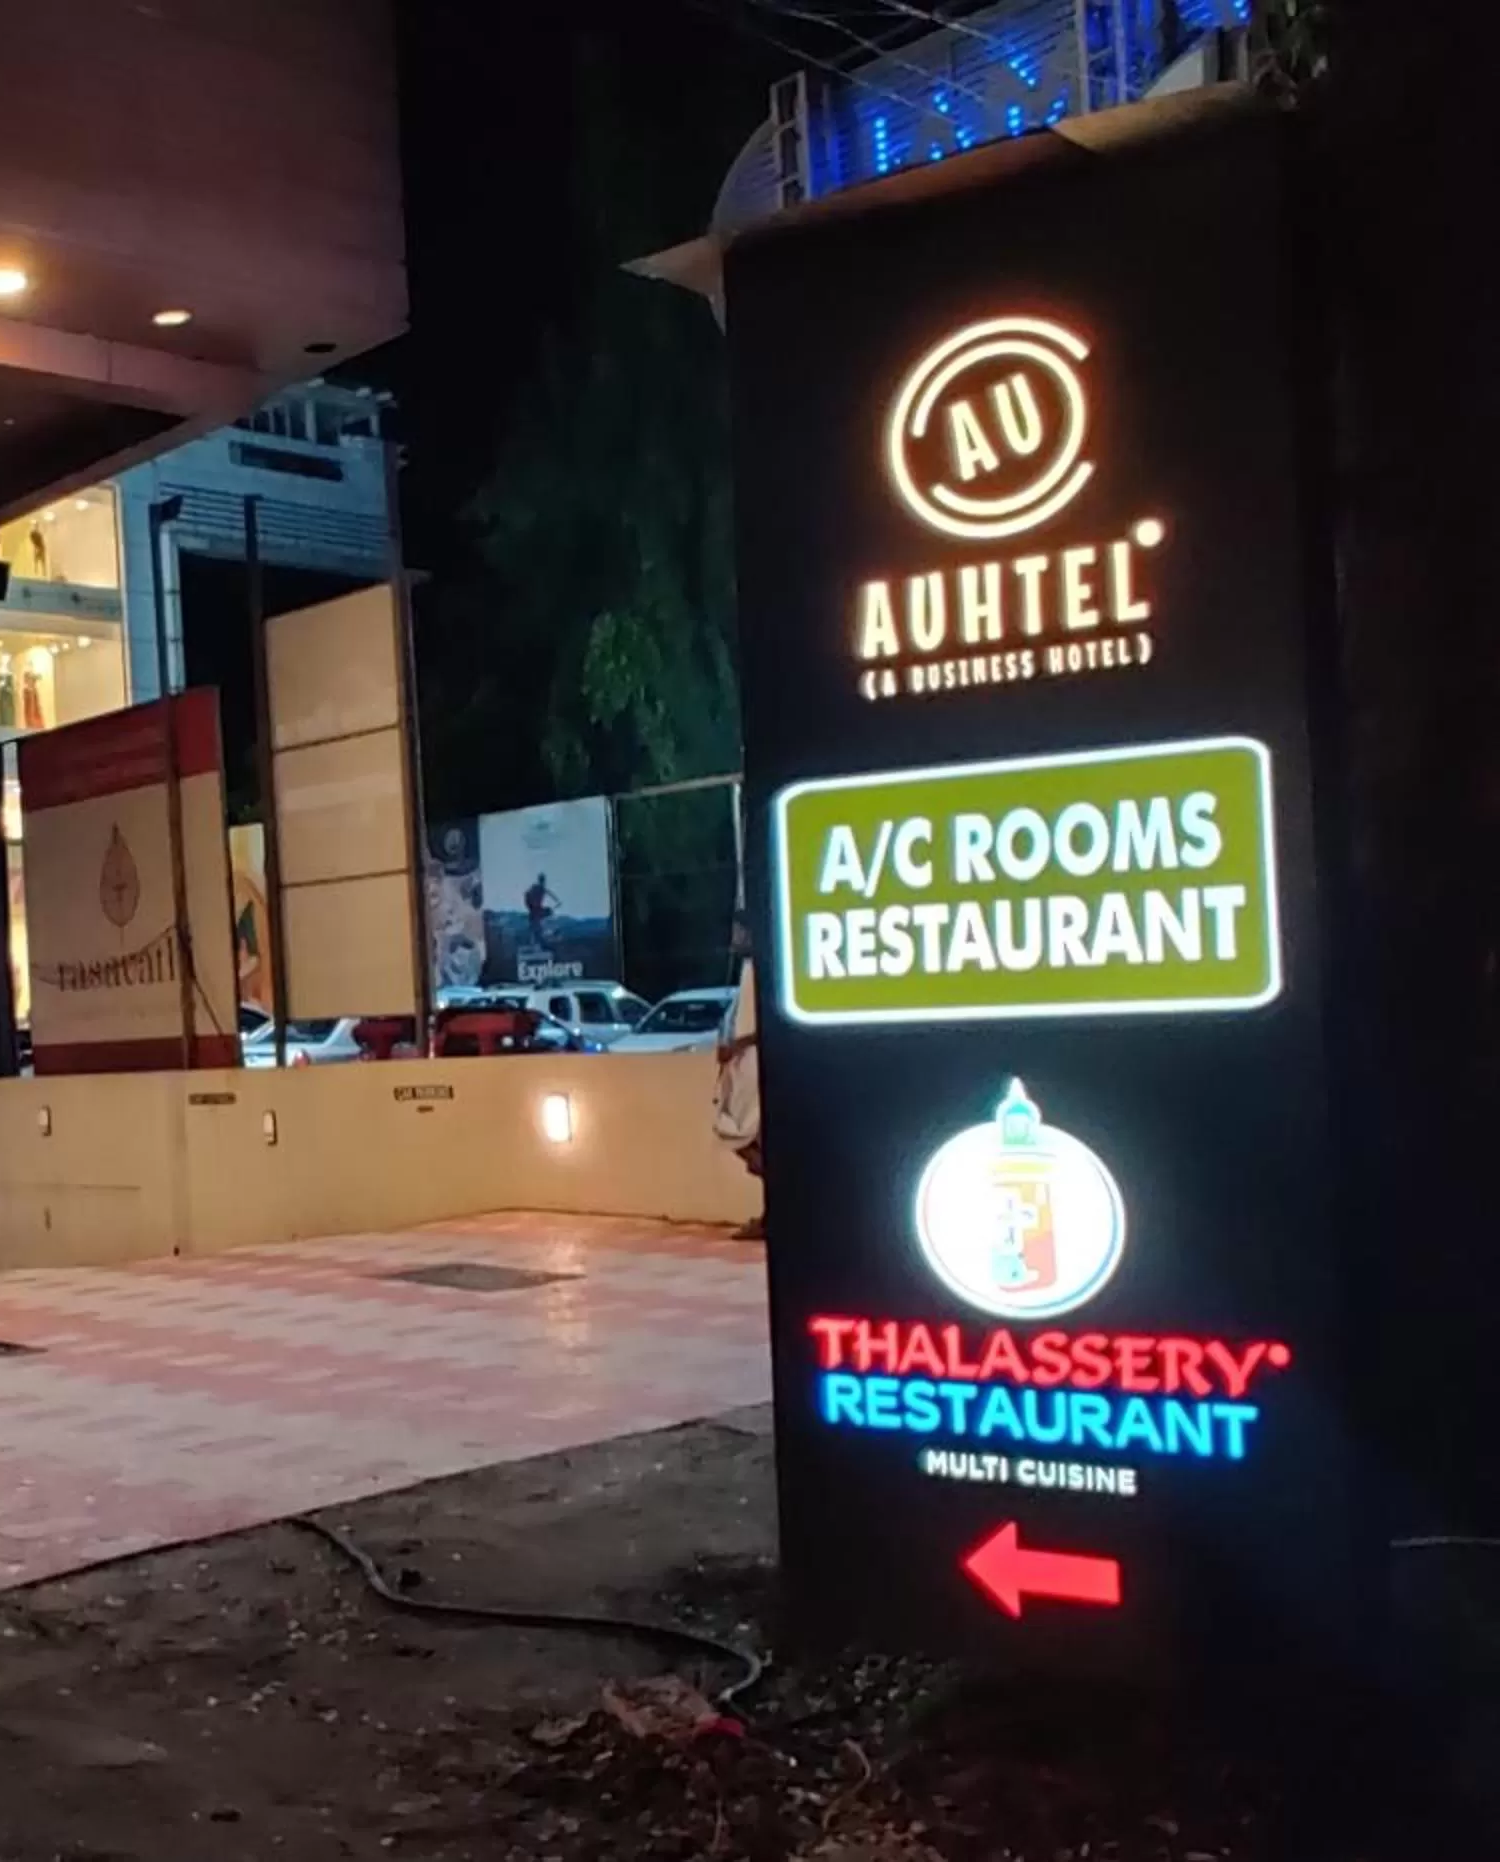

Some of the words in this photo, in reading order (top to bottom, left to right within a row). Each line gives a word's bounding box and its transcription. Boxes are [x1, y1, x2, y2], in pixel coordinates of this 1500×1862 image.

[947, 373, 1044, 482] AU
[859, 541, 1152, 660] AUHTEL
[910, 649, 1036, 694] BUSINESS
[819, 820, 932, 897] A/C
[952, 791, 1222, 884] ROOMS
[517, 960, 583, 984] Explore
[806, 886, 1246, 980] RESTAURANT
[809, 1315, 1267, 1398] THALASSERY
[823, 1374, 1259, 1460] RESTAURANT
[924, 1450, 1008, 1483] MULTI
[1017, 1461, 1138, 1496] CUISINE
